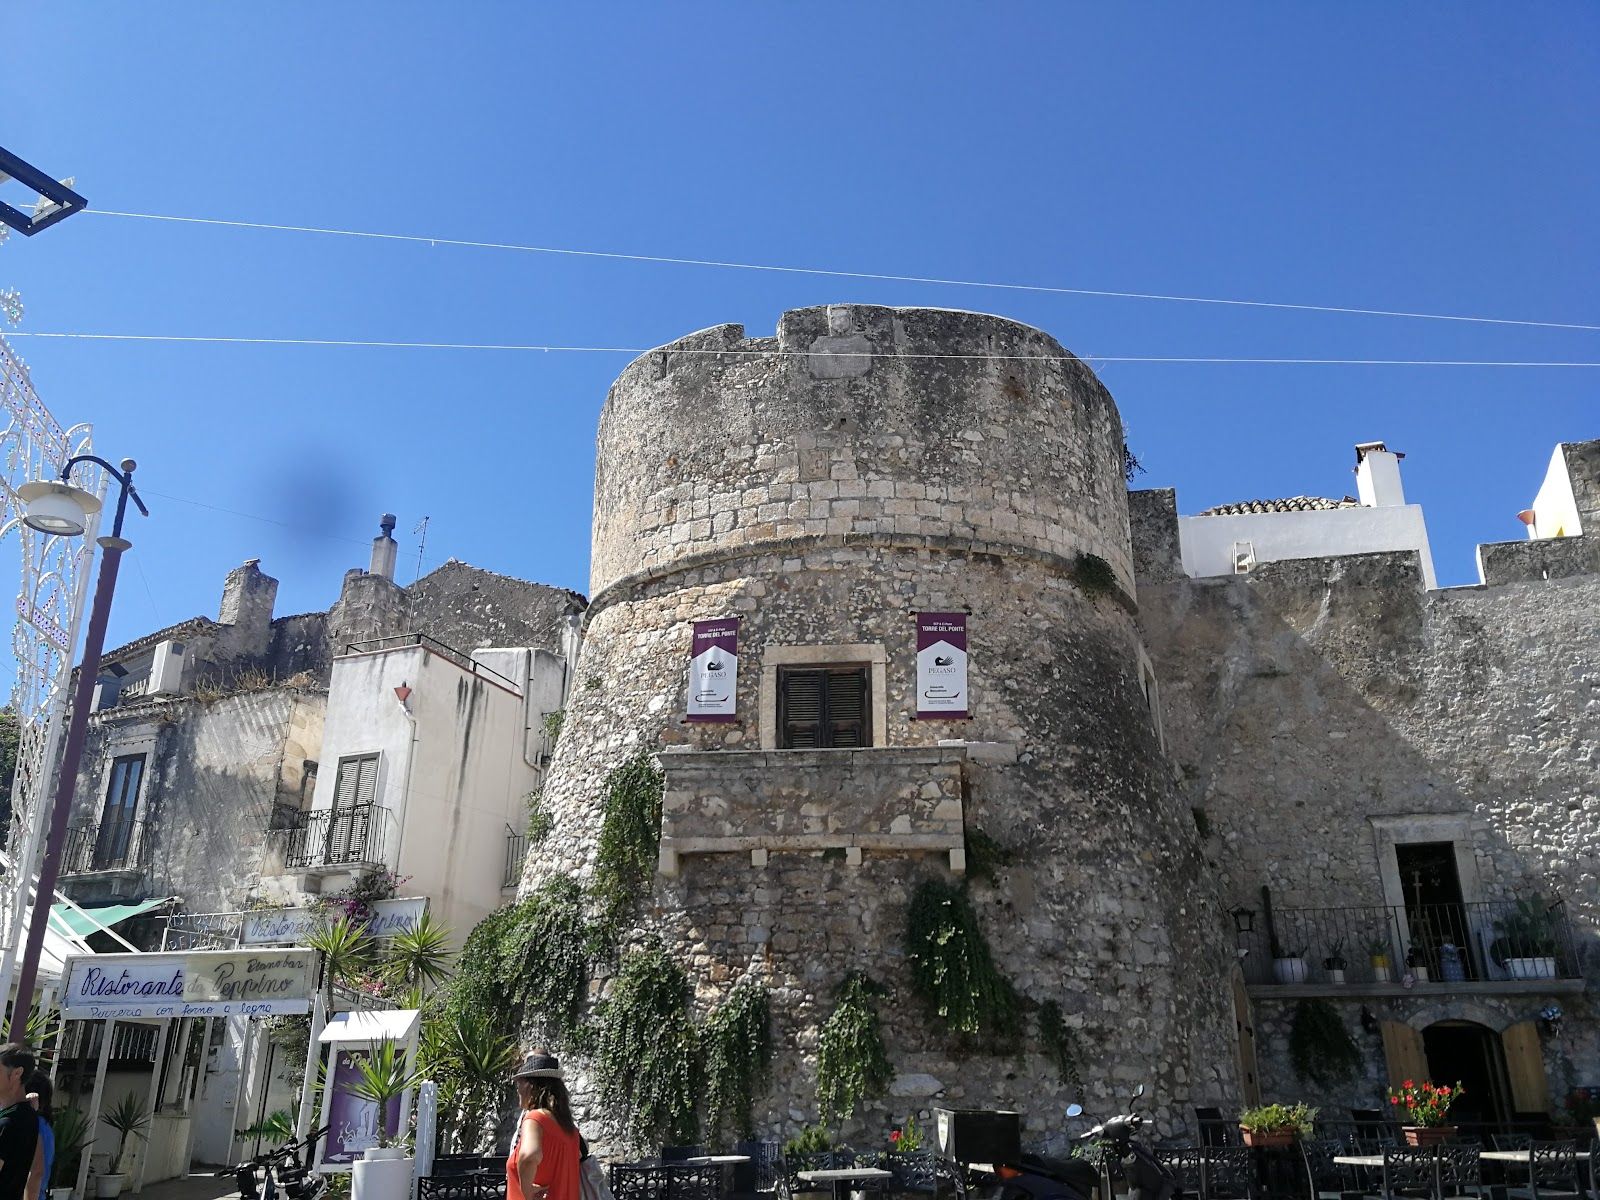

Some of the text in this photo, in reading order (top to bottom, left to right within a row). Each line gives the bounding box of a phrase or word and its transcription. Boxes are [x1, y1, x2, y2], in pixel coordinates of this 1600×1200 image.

[700, 671, 727, 679] PEGASO
[80, 967, 184, 997] Ristorante
[211, 962, 294, 1000] Peppino
[156, 1007, 174, 1016] con
[181, 1004, 214, 1016] forno
[240, 1002, 272, 1015] legna
